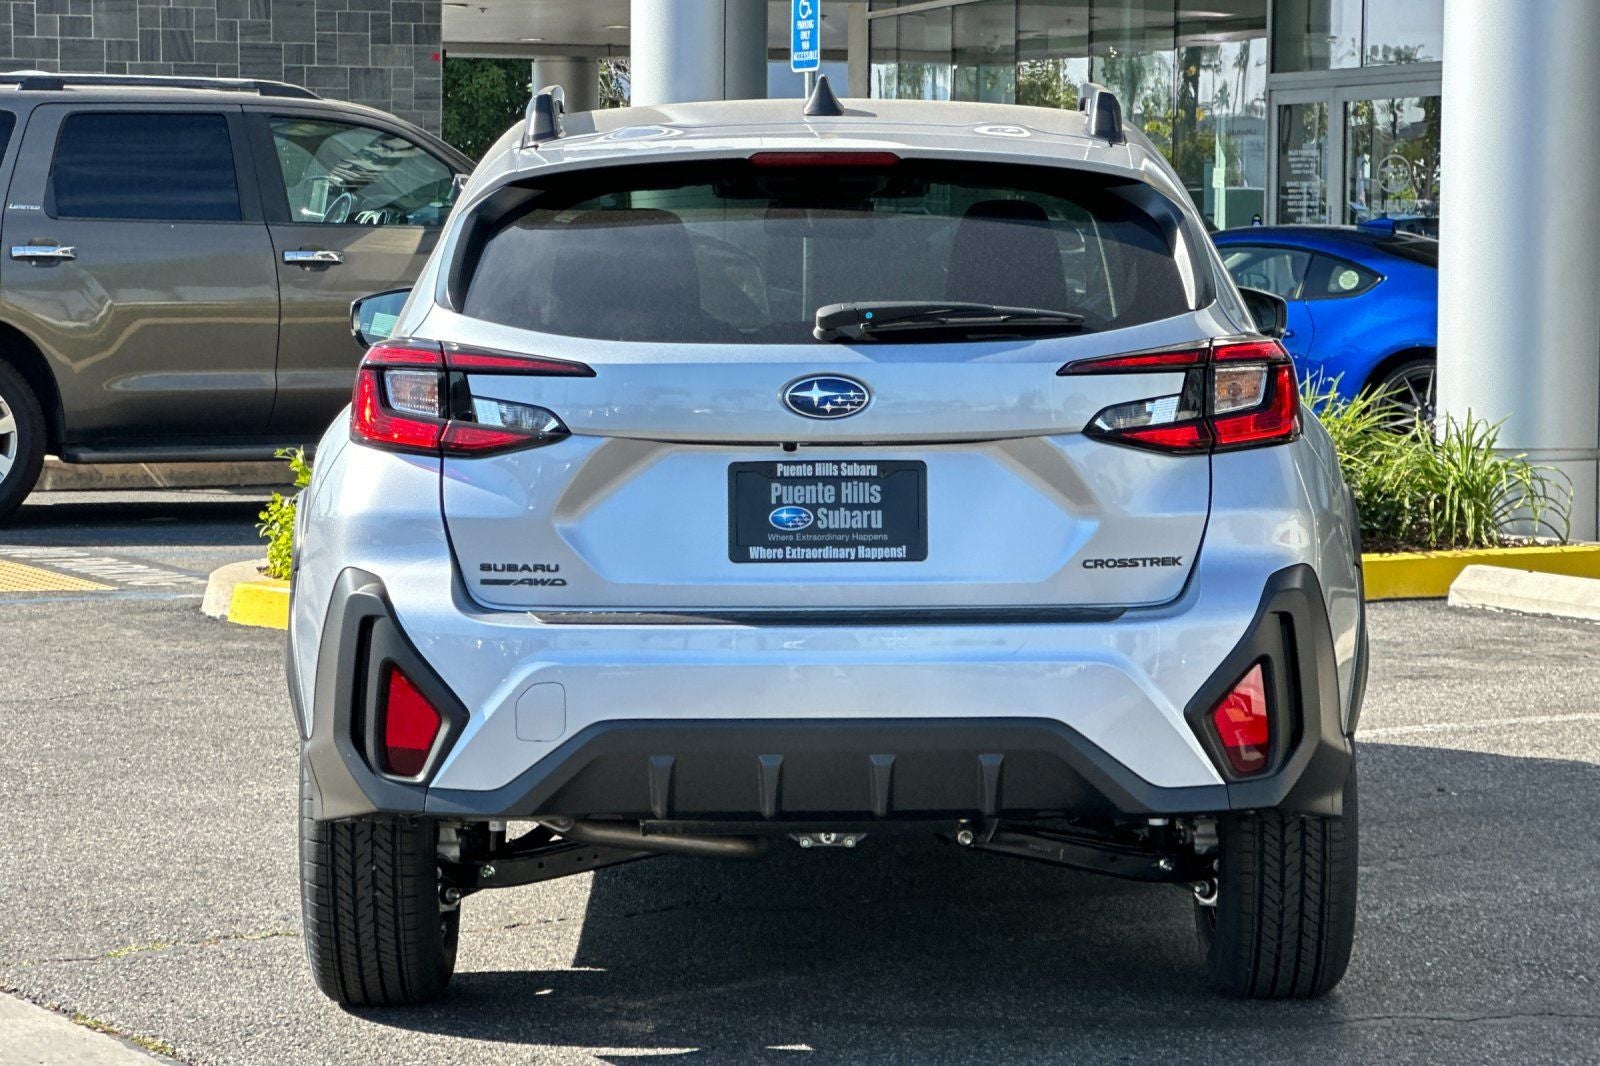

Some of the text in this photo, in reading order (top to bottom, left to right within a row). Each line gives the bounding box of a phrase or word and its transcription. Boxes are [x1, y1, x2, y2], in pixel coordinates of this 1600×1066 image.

[776, 463, 877, 477] Puente Hills Subaru
[771, 481, 881, 504] Puente Hills
[817, 507, 882, 529] Subaru
[768, 533, 888, 542] Where Extraordinary Happens
[749, 545, 907, 560] Where Extraordinary Happens!
[479, 563, 560, 573] SUBARU
[1082, 556, 1183, 569] CROSSTREK
[512, 578, 567, 586] AWD
